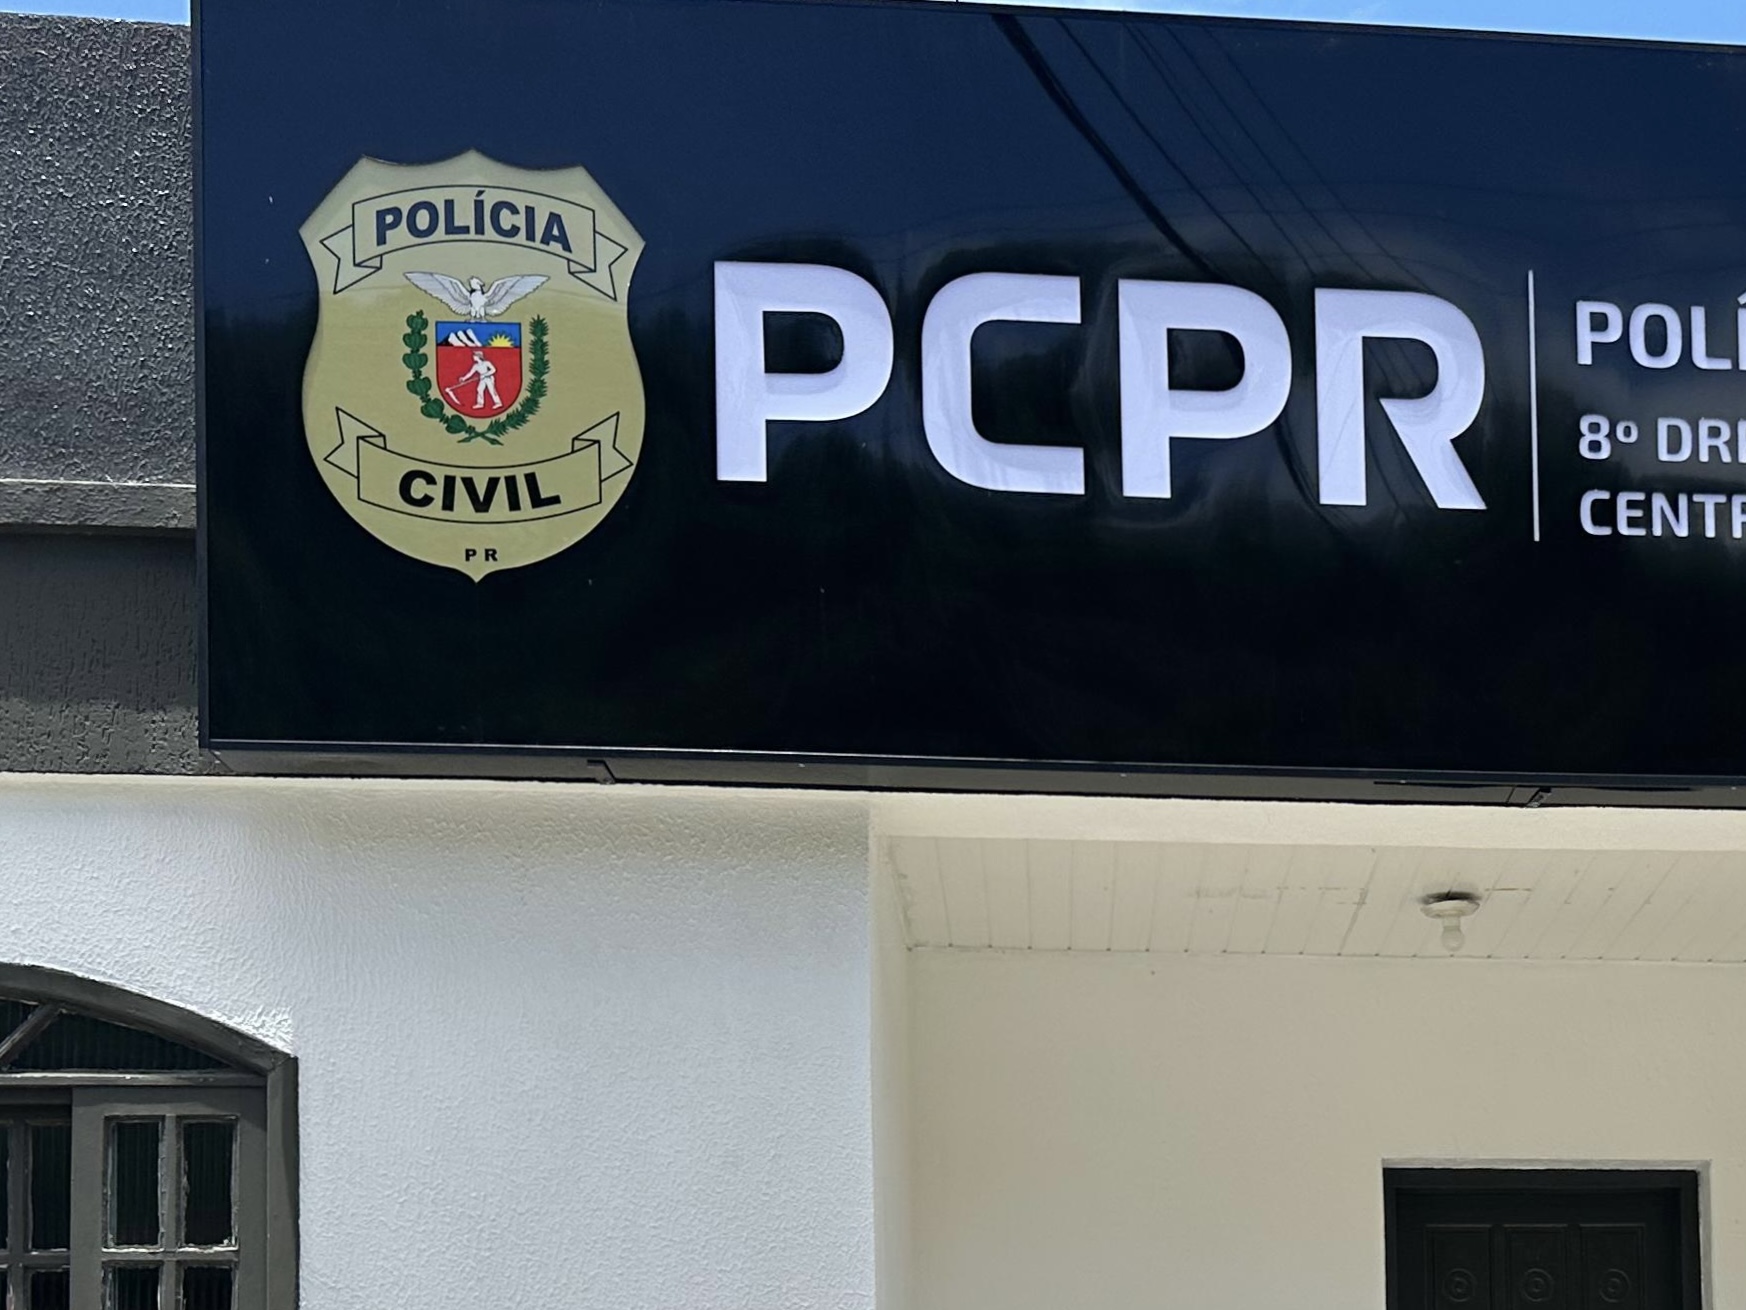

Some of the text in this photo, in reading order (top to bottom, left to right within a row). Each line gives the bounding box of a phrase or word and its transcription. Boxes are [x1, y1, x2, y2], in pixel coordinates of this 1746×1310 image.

[375, 190, 573, 253] POLÍCIA
[714, 261, 1488, 510] PCPR
[399, 469, 562, 513] CIVIL
